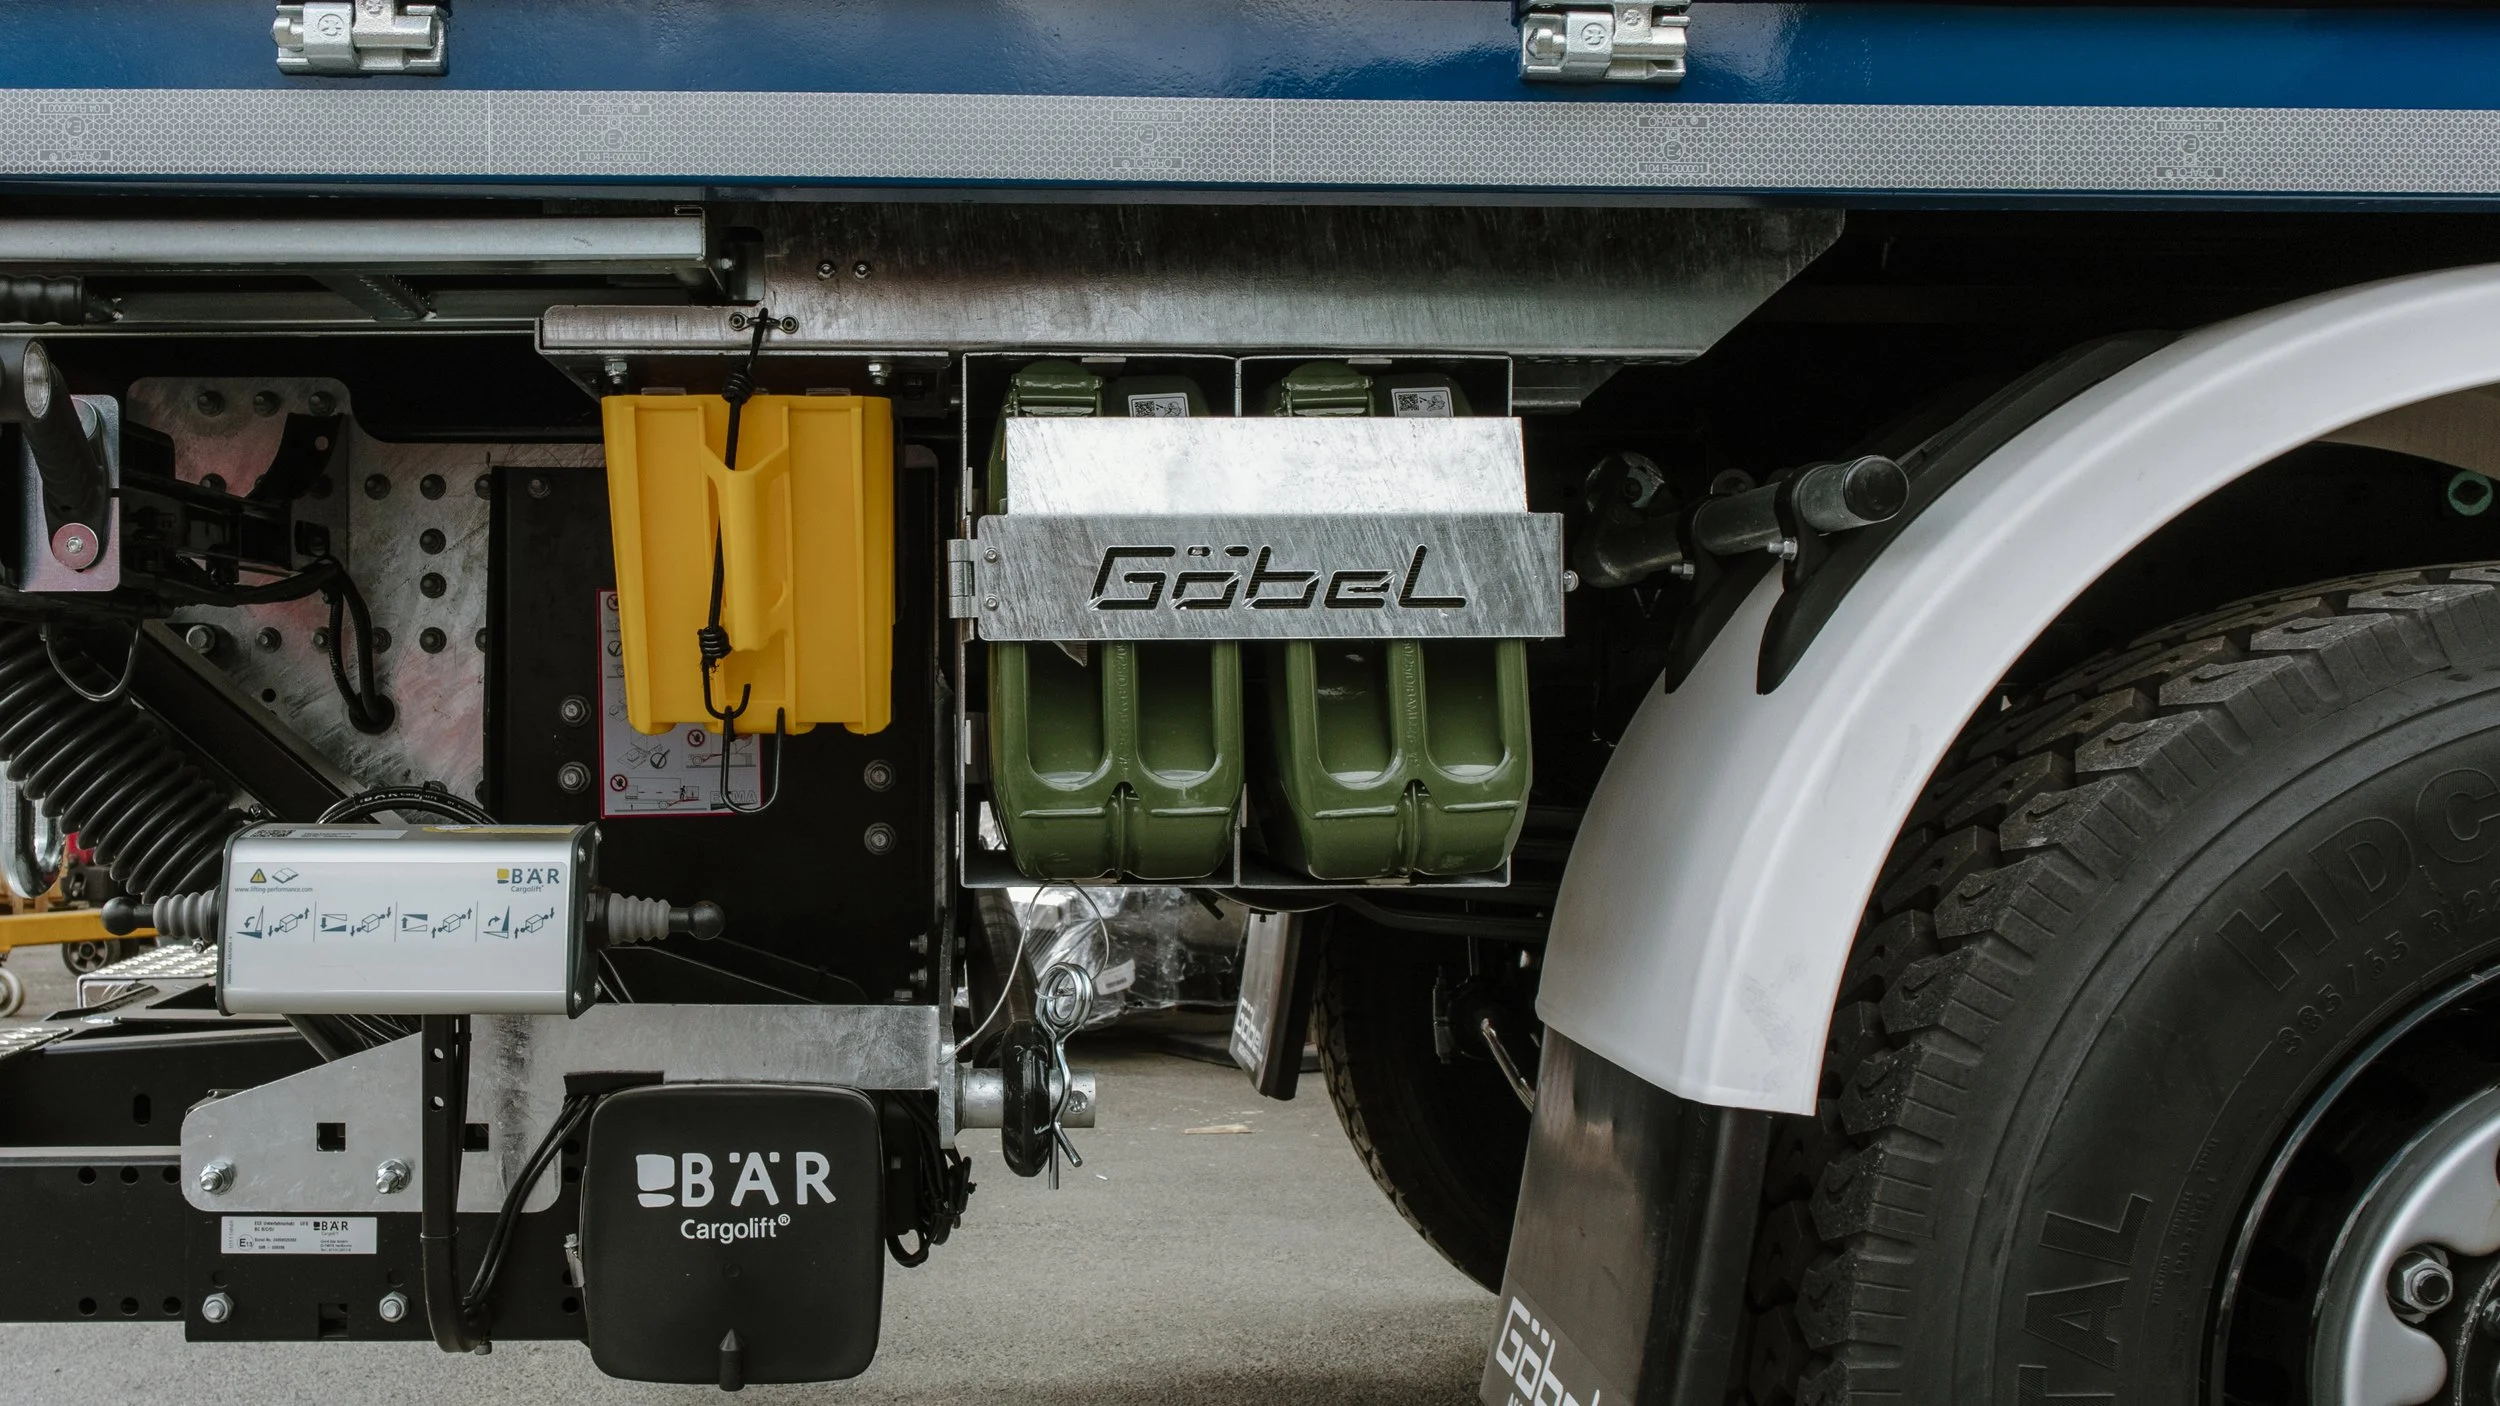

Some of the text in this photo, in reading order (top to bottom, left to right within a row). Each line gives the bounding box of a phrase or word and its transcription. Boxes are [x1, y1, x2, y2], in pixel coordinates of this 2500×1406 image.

[511, 868, 560, 884] BÄR
[234, 885, 313, 895] www.lifting-performance.com
[681, 1151, 837, 1208] BÄR
[321, 1220, 349, 1231] BÄR
[1496, 1296, 1600, 1406] Göb
